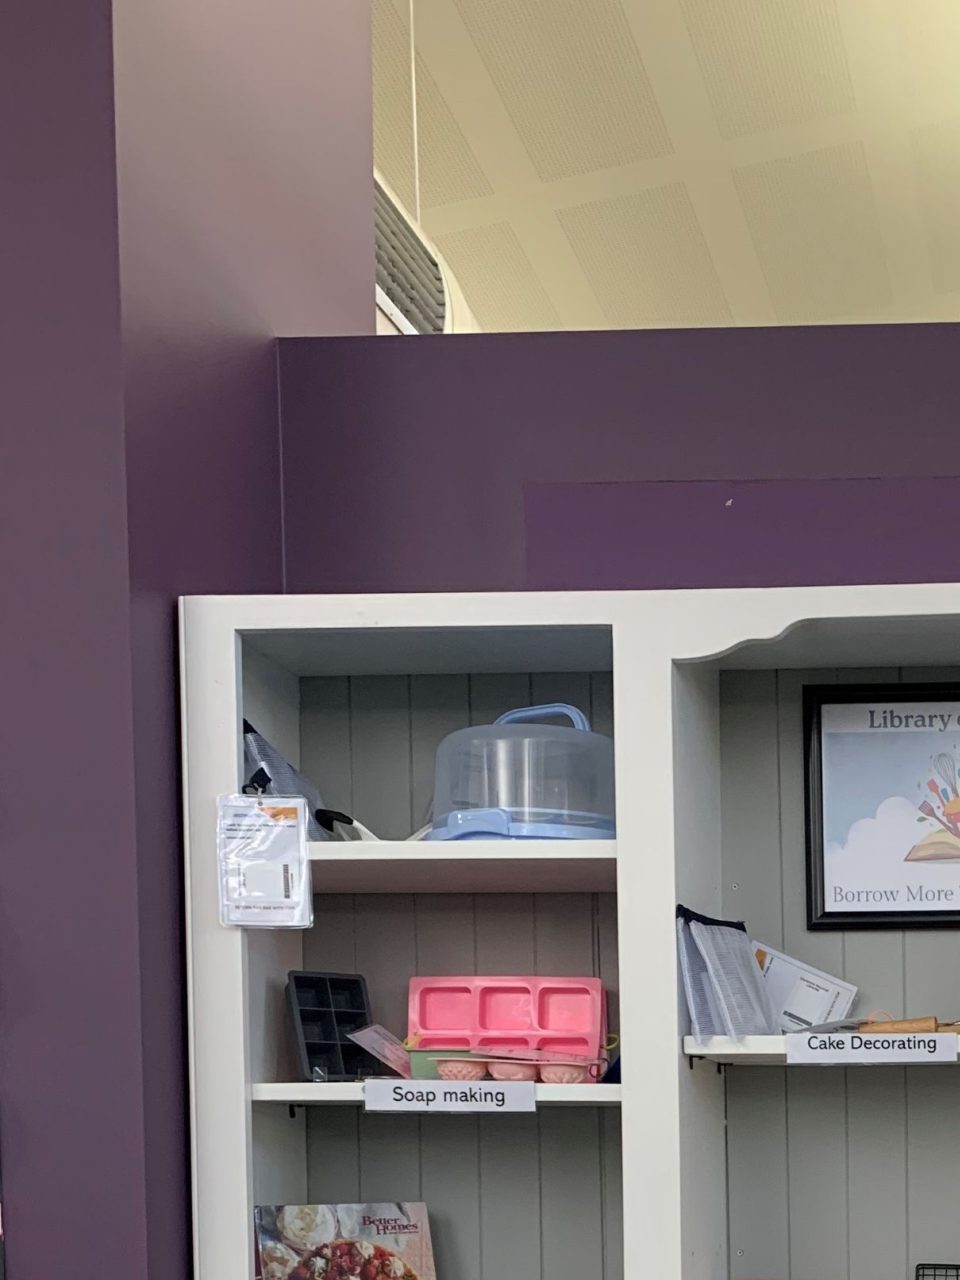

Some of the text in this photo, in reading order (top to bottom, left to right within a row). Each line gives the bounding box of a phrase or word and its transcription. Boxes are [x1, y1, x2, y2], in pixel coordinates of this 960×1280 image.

[868, 709, 951, 732] Library
[833, 885, 900, 903] Borrow
[906, 885, 954, 902] More
[807, 1035, 937, 1054] Cake Decorating
[392, 1086, 505, 1107] Soap making
[362, 1215, 400, 1226] Better
[376, 1223, 418, 1235] Homes
